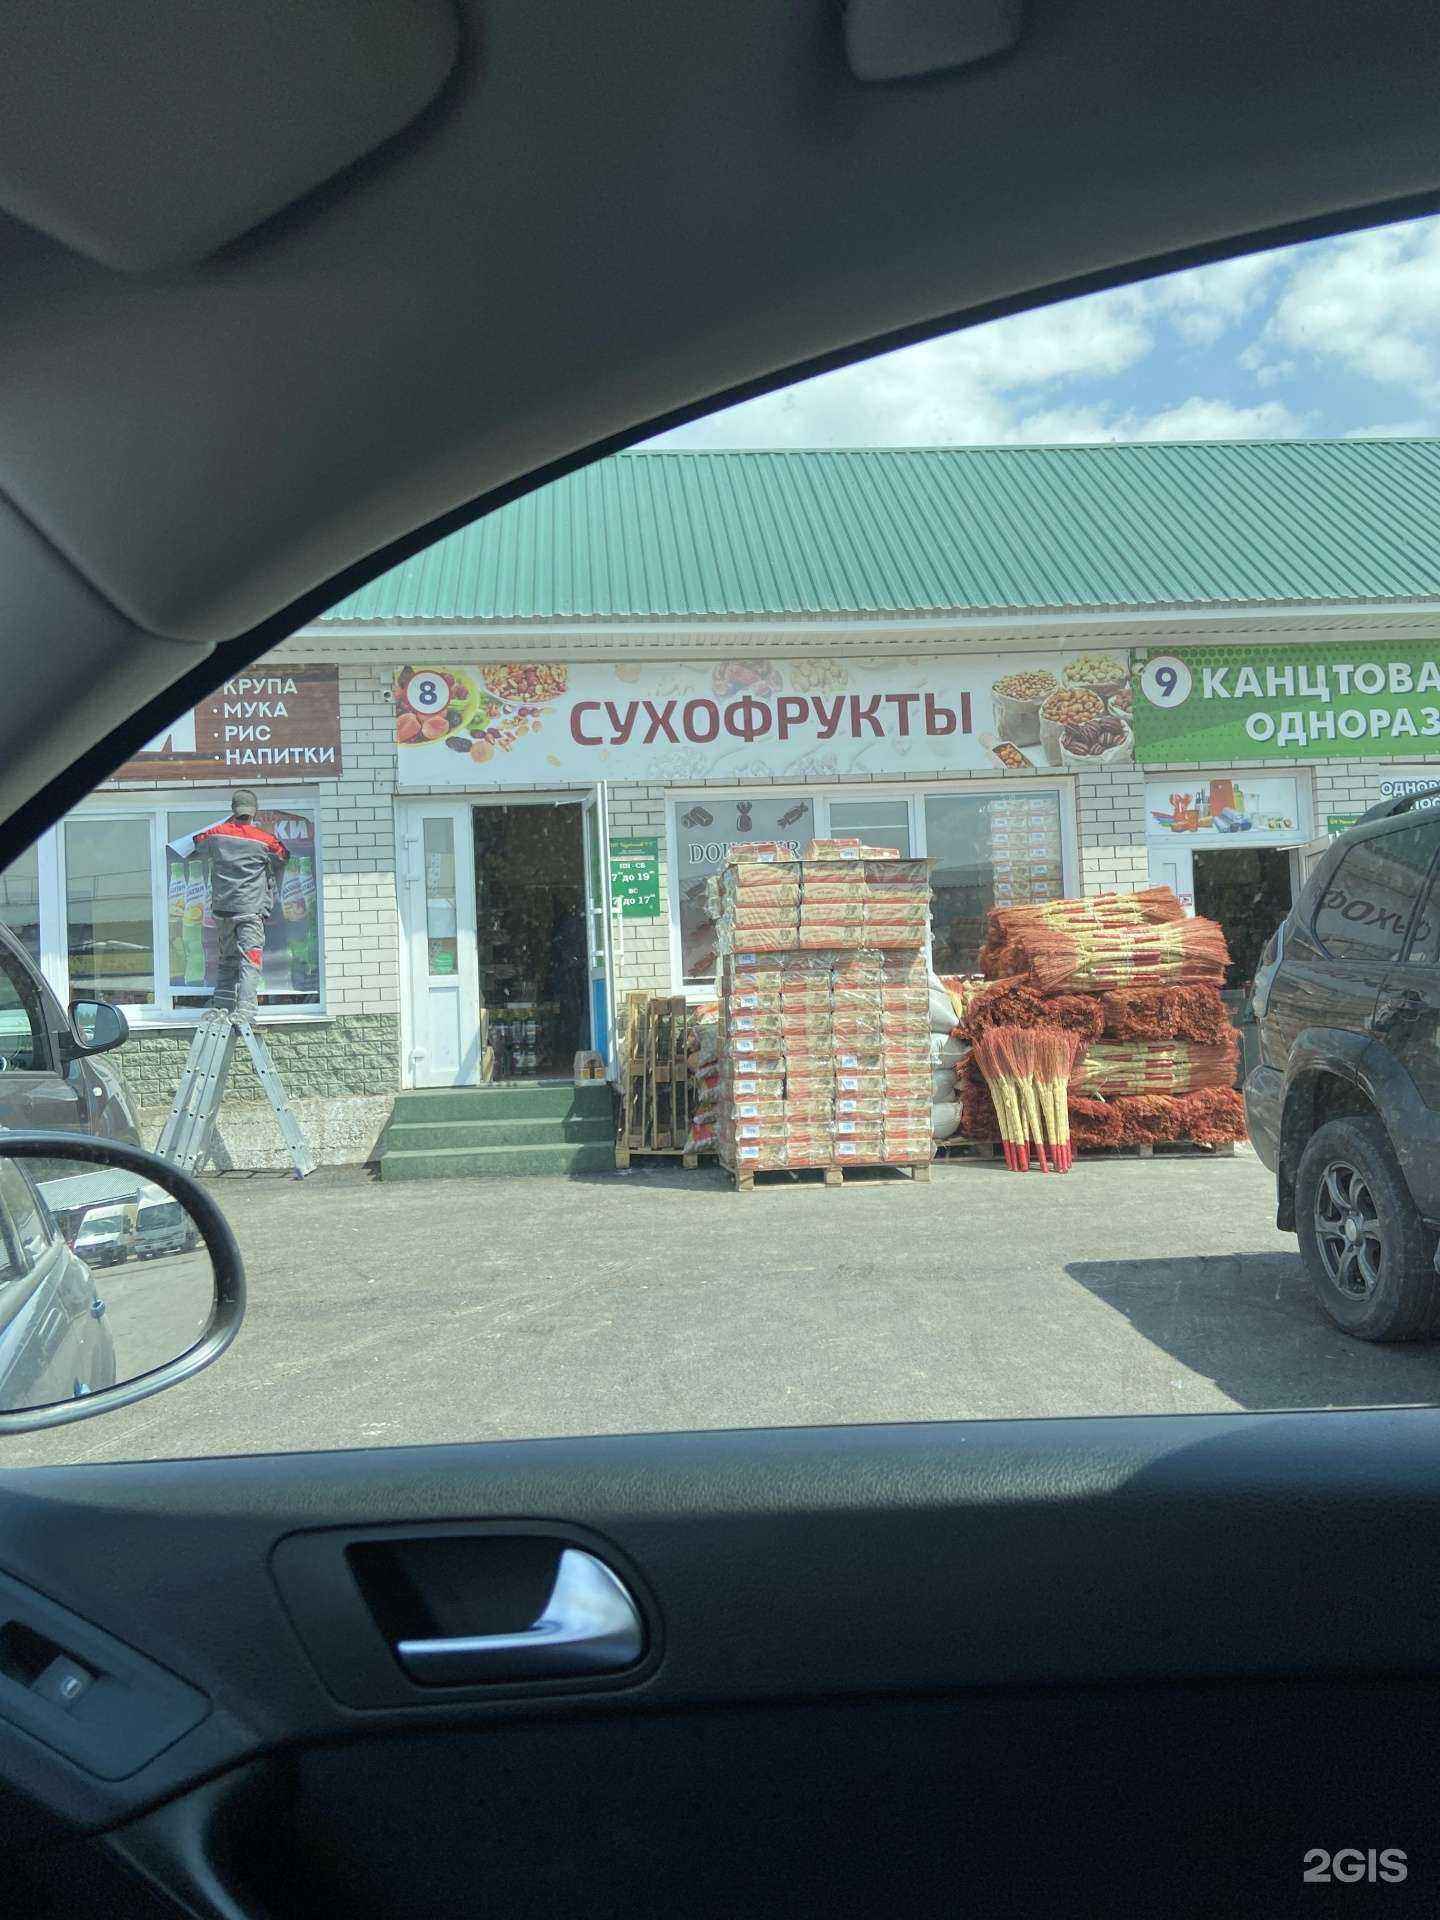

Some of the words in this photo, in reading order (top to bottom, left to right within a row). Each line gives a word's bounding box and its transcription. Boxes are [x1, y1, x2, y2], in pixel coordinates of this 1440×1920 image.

[223, 678, 298, 695] КРУПА
[1155, 667, 1178, 696] 9
[419, 681, 438, 705] 8
[224, 702, 288, 718] МУКА
[570, 692, 972, 746] СУХОФРУКТЫ
[225, 725, 272, 742] РИС
[226, 747, 335, 765] НАПИТКИ
